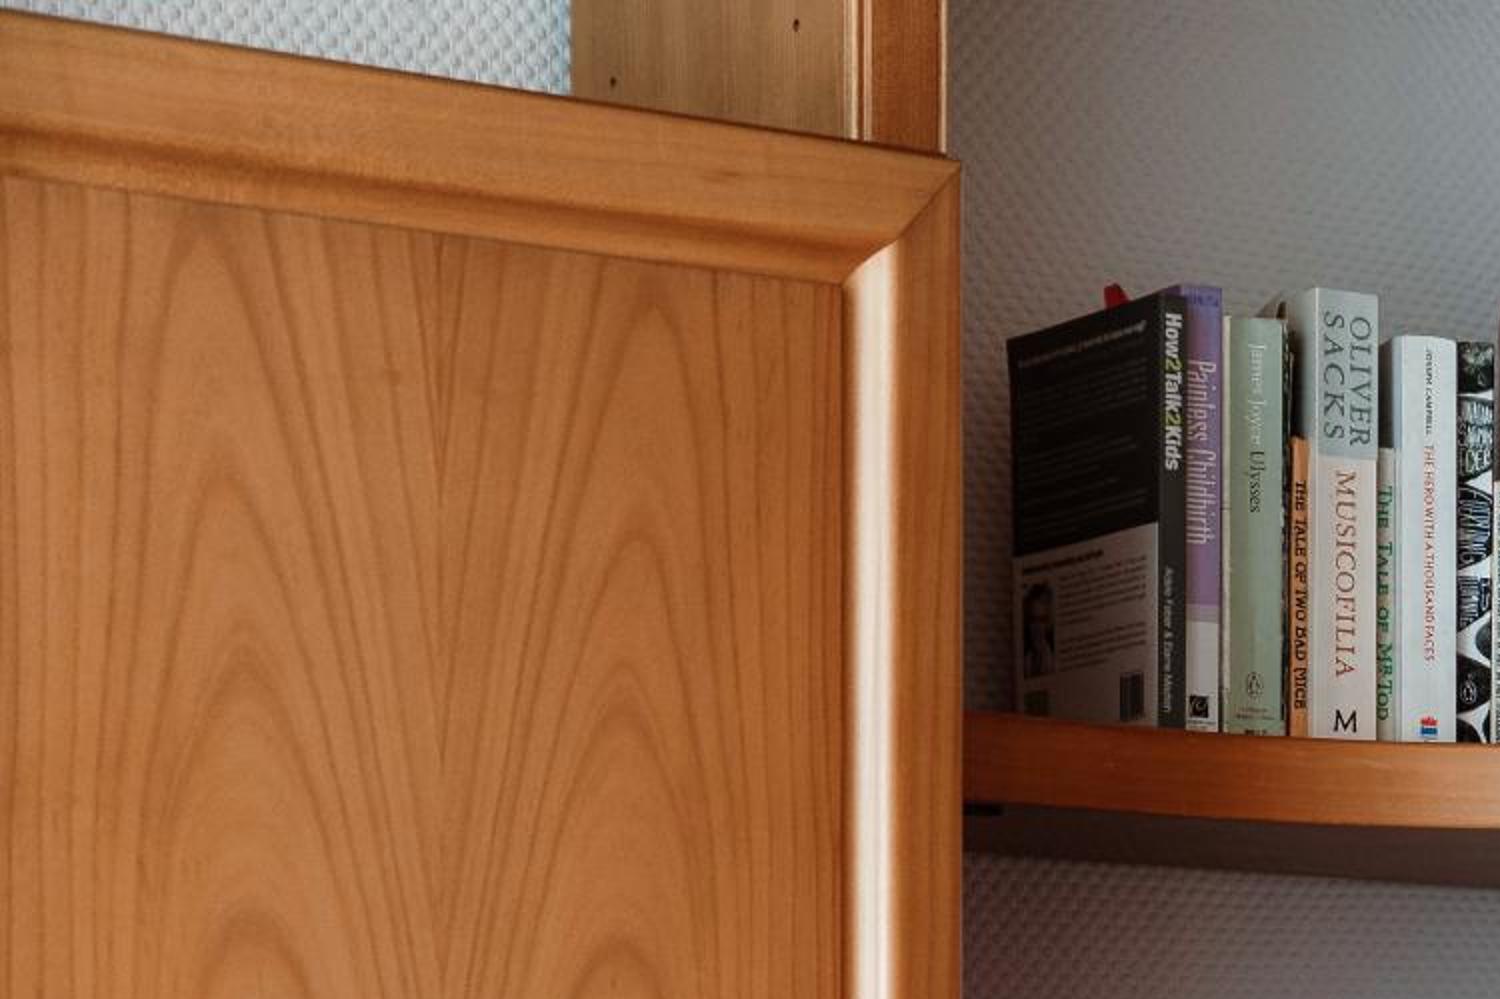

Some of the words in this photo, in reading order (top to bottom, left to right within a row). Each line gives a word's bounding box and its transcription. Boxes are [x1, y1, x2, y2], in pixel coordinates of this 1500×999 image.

[1249, 343, 1267, 392] James
[1324, 311, 1345, 439] SACKS
[1350, 317, 1372, 447] OLIVER
[1164, 313, 1183, 471] How2Talk2Kids
[1187, 359, 1217, 441] Painless
[1424, 445, 1435, 467] THE
[1186, 450, 1216, 544] Childbirth
[1246, 450, 1265, 513] Ulysses
[1295, 480, 1307, 511] THE
[1424, 471, 1435, 506] HERO
[1377, 485, 1393, 528] THE
[1424, 507, 1435, 540] WITH
[1295, 519, 1307, 557] TALE
[1424, 541, 1435, 550] A
[1295, 562, 1307, 582] OF
[1335, 471, 1357, 682] MUSICOFILIA
[1377, 541, 1393, 596] TALE
[1424, 552, 1435, 622] THOUSAND
[1295, 589, 1307, 621] TWO
[1377, 607, 1390, 634] OF
[1295, 626, 1307, 660] BAD
[1424, 624, 1435, 662] FACES
[1295, 667, 1307, 709] MICE
[1377, 680, 1393, 721] TOD
[1333, 709, 1357, 733] M
